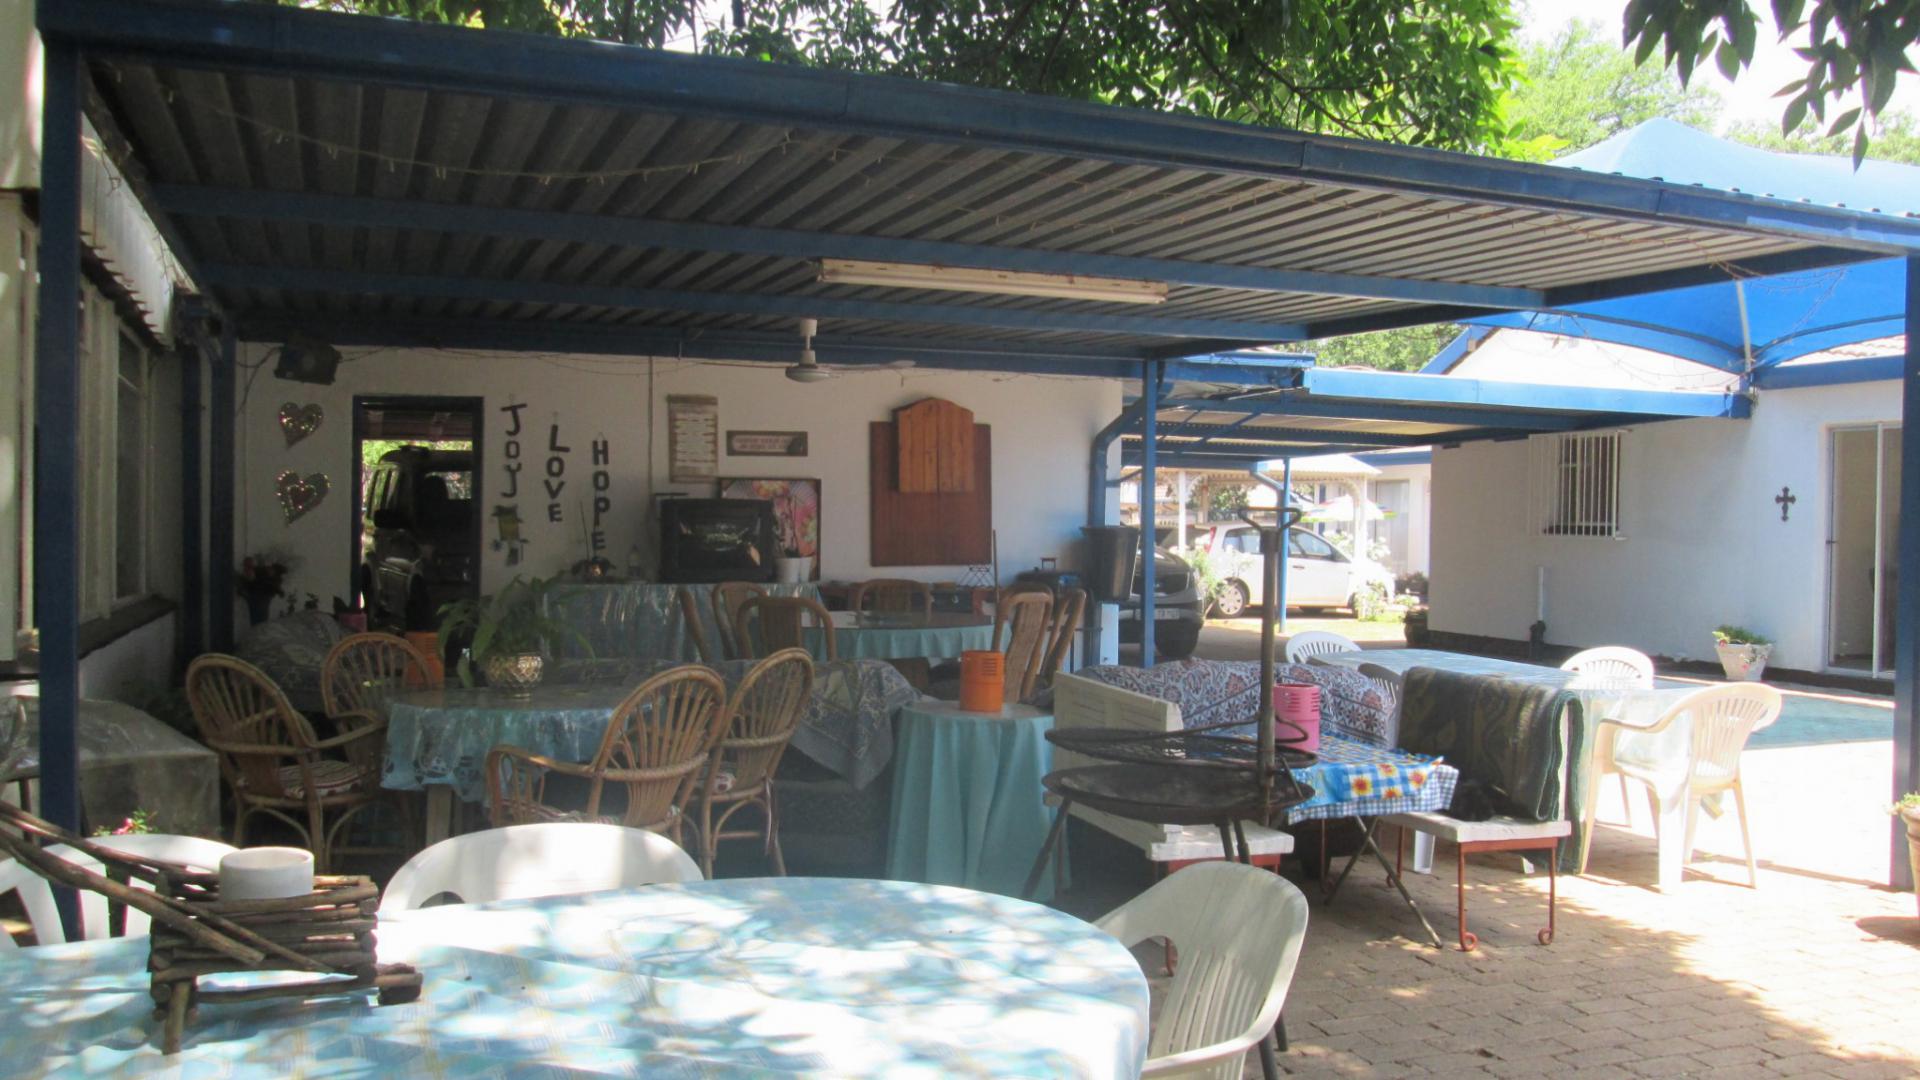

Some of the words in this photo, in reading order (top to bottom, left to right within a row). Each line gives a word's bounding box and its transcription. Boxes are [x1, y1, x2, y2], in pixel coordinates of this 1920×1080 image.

[500, 403, 527, 497] JOY
[543, 424, 571, 523] LOVE
[591, 440, 611, 550] HOPE
